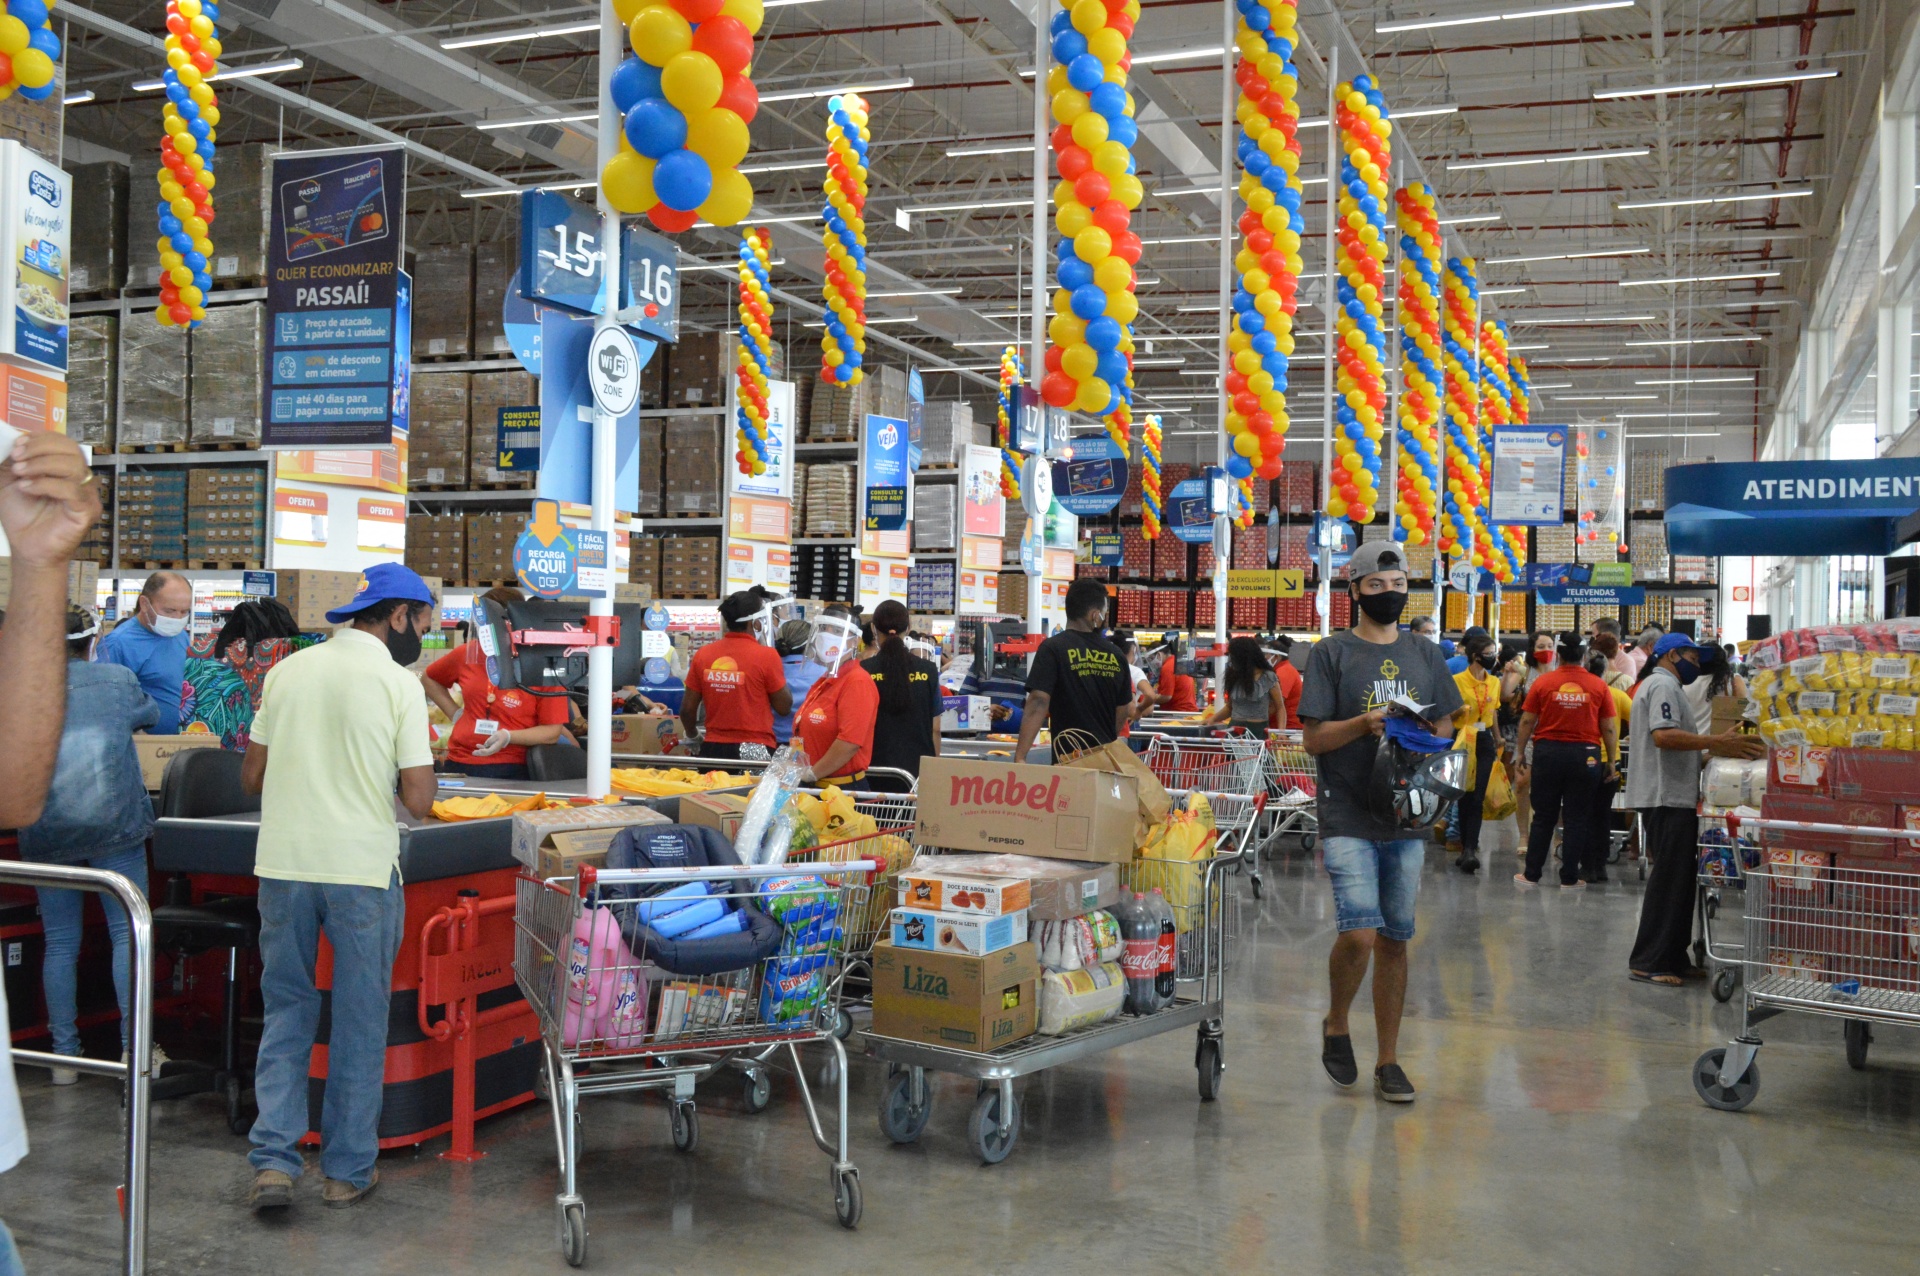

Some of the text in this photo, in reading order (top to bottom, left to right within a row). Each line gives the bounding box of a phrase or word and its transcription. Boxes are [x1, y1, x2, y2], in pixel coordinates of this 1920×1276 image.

[32, 172, 54, 191] Gomes
[343, 171, 371, 185] Itaucard
[36, 187, 52, 201] Costa
[298, 184, 320, 196] PASSAÍ
[34, 216, 47, 228] com
[554, 223, 595, 278] 15
[276, 262, 394, 281] QUER ECONOMIZAR?
[639, 258, 672, 307] 16
[296, 279, 369, 307] PASSAÍ!
[305, 317, 372, 330] Preço de atacado
[311, 330, 333, 341] partir
[335, 329, 345, 338] de
[328, 356, 338, 365] de
[341, 355, 381, 365] desconto
[305, 368, 356, 378] em cinemas
[603, 384, 623, 398] ZONE
[296, 394, 368, 405] até 40 dias para
[52, 407, 65, 423] 07
[295, 405, 384, 418] pagar suas compras
[503, 411, 540, 420] CONSULTE
[503, 419, 526, 429] PREÇO
[1025, 405, 1039, 433] 17
[1053, 414, 1067, 442] 18
[878, 431, 898, 447] VEJA
[288, 496, 315, 508] OFERTA
[369, 505, 394, 517] OFERTA
[732, 513, 744, 523] 05
[863, 533, 874, 543] 04
[583, 543, 604, 551] RÁPIDO!
[528, 550, 565, 559] RECARGA
[578, 550, 604, 559] DIRETO
[528, 559, 567, 574] AQUI!
[1067, 648, 1120, 667] PLAZZA
[707, 670, 740, 683] ASSAÍ
[1555, 693, 1586, 702] ASSAÍ
[1661, 702, 1672, 720] 8
[950, 771, 1061, 814] mabel
[988, 836, 1025, 846] PEPSICO
[970, 886, 995, 894] ABÓBORA
[10, 953, 20, 961] 15
[903, 964, 949, 996] Liza
[991, 1018, 1013, 1040] Liza
